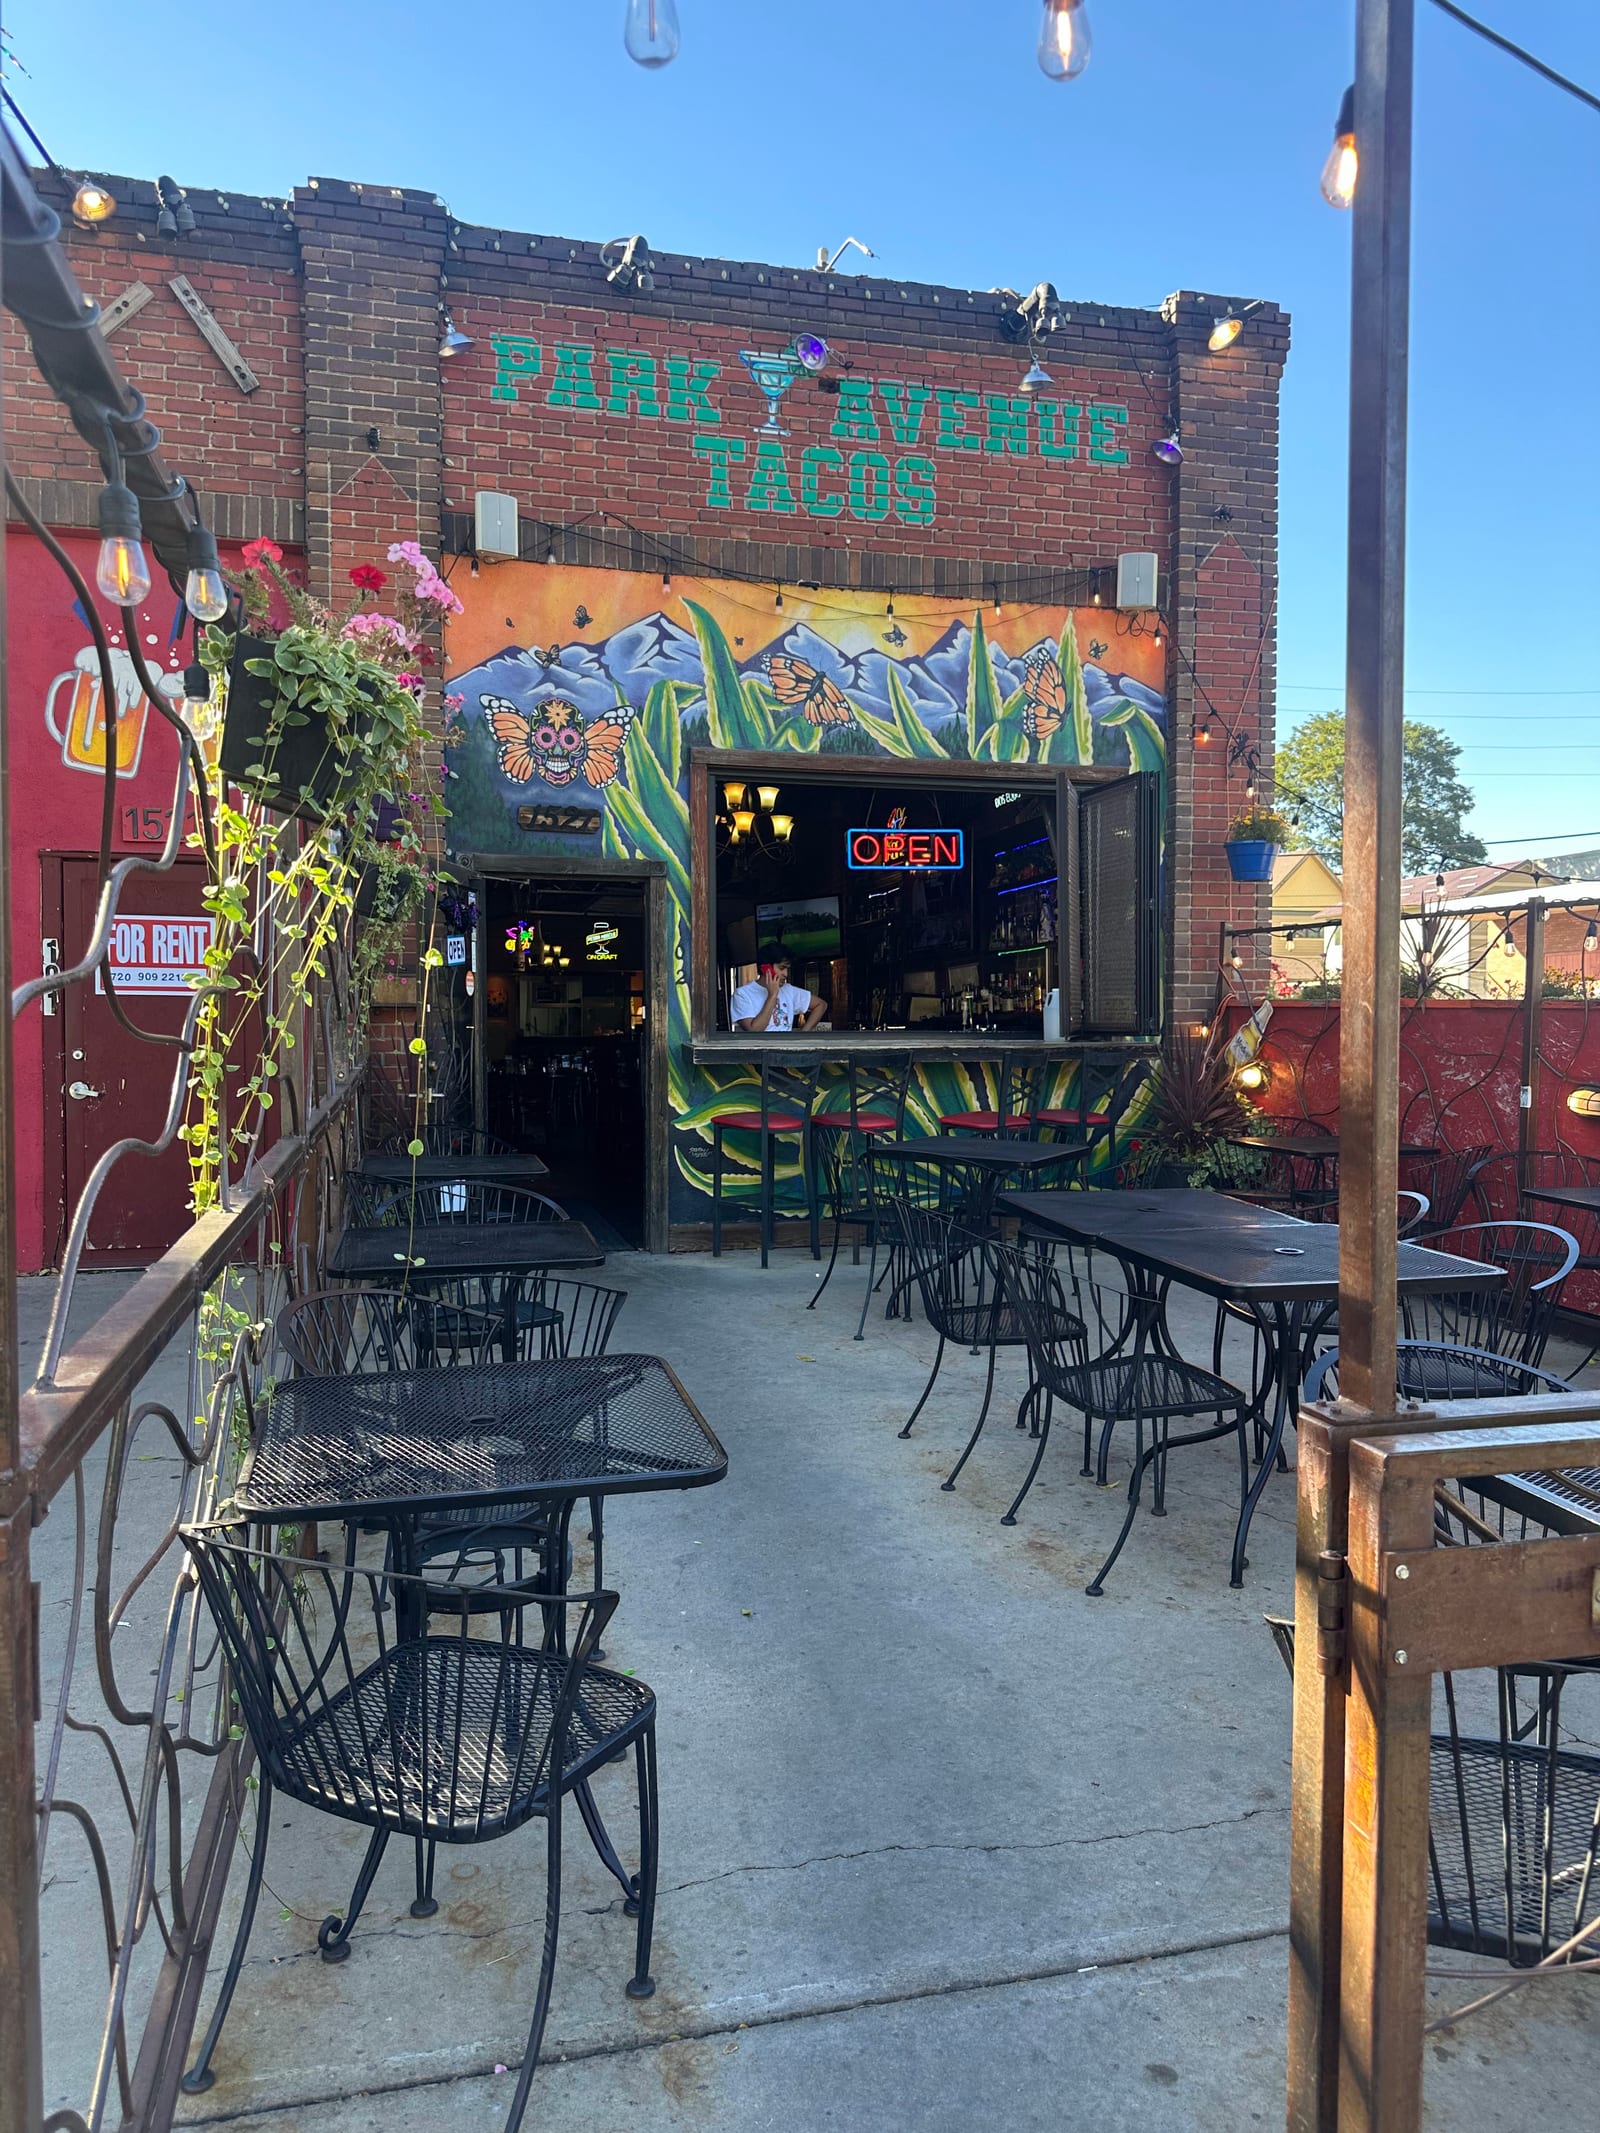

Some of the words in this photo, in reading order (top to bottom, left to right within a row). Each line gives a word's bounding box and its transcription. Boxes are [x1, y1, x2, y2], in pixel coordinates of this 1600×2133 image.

[490, 333, 721, 427] PARK
[829, 376, 1129, 468] AVENUE
[692, 431, 937, 526] TACOS
[527, 804, 595, 832] 1527
[853, 835, 957, 863] OPEN
[109, 923, 146, 964] FOR
[152, 924, 208, 965] RENT
[448, 941, 465, 961] OPEN
[111, 972, 131, 982] 720
[138, 972, 158, 981] 909
[161, 973, 186, 981] 221
